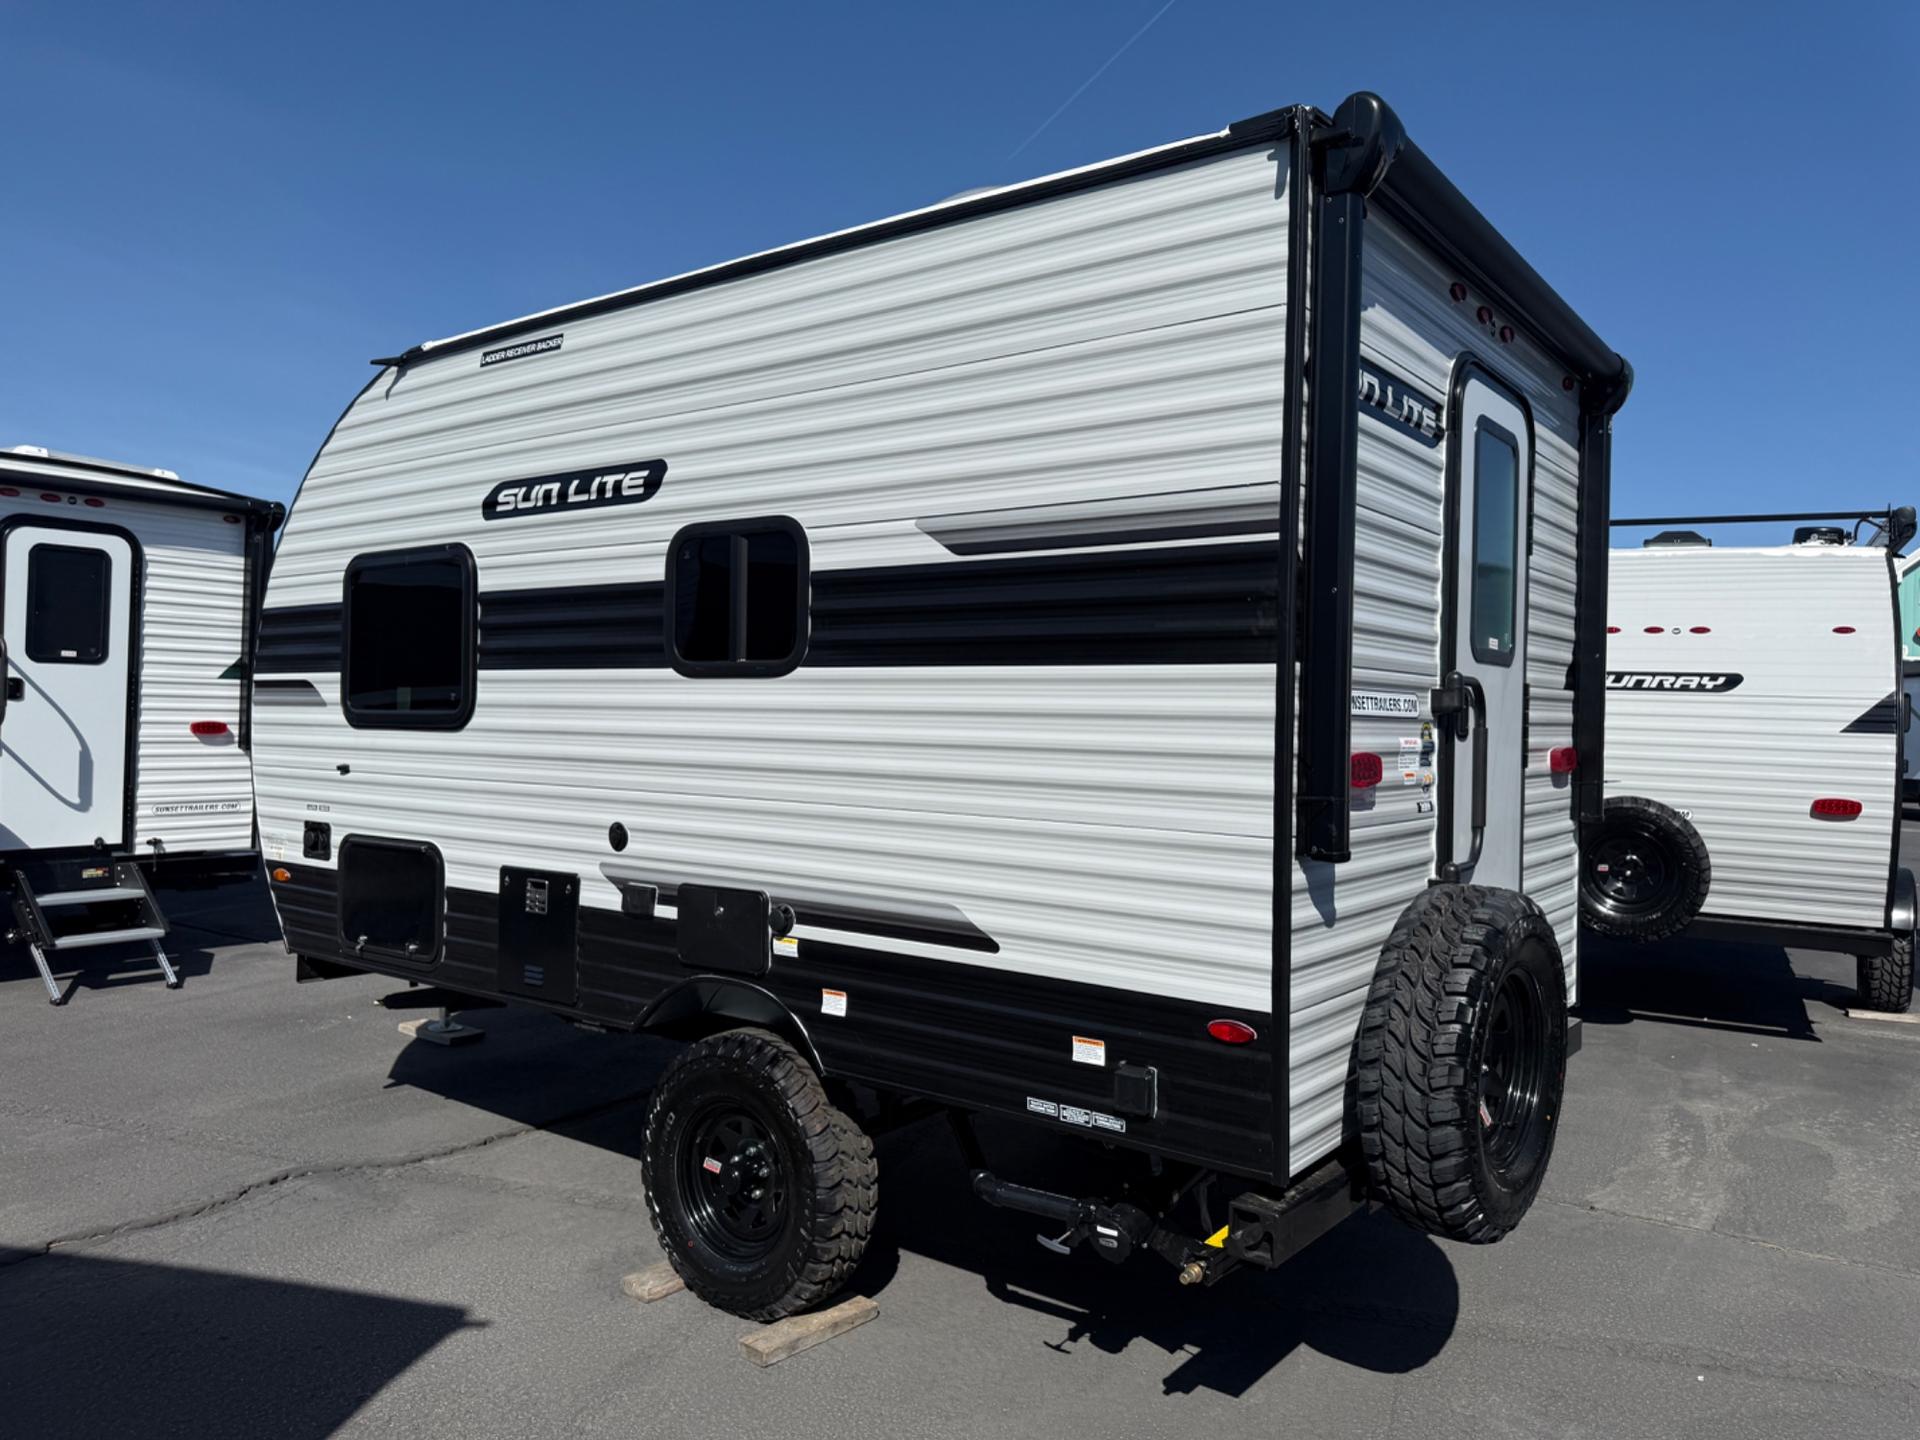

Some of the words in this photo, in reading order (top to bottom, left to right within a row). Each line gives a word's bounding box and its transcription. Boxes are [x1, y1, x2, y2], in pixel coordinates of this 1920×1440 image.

[482, 350, 505, 364] LADDER
[506, 344, 536, 358] RECEIVER
[537, 337, 563, 351] BACKER
[1383, 385, 1437, 438] LITE
[495, 482, 561, 512] SUN
[567, 470, 650, 503] LITE
[1606, 674, 1726, 689] UNRAY
[1351, 695, 1418, 713] NSETTRAILERS.COM
